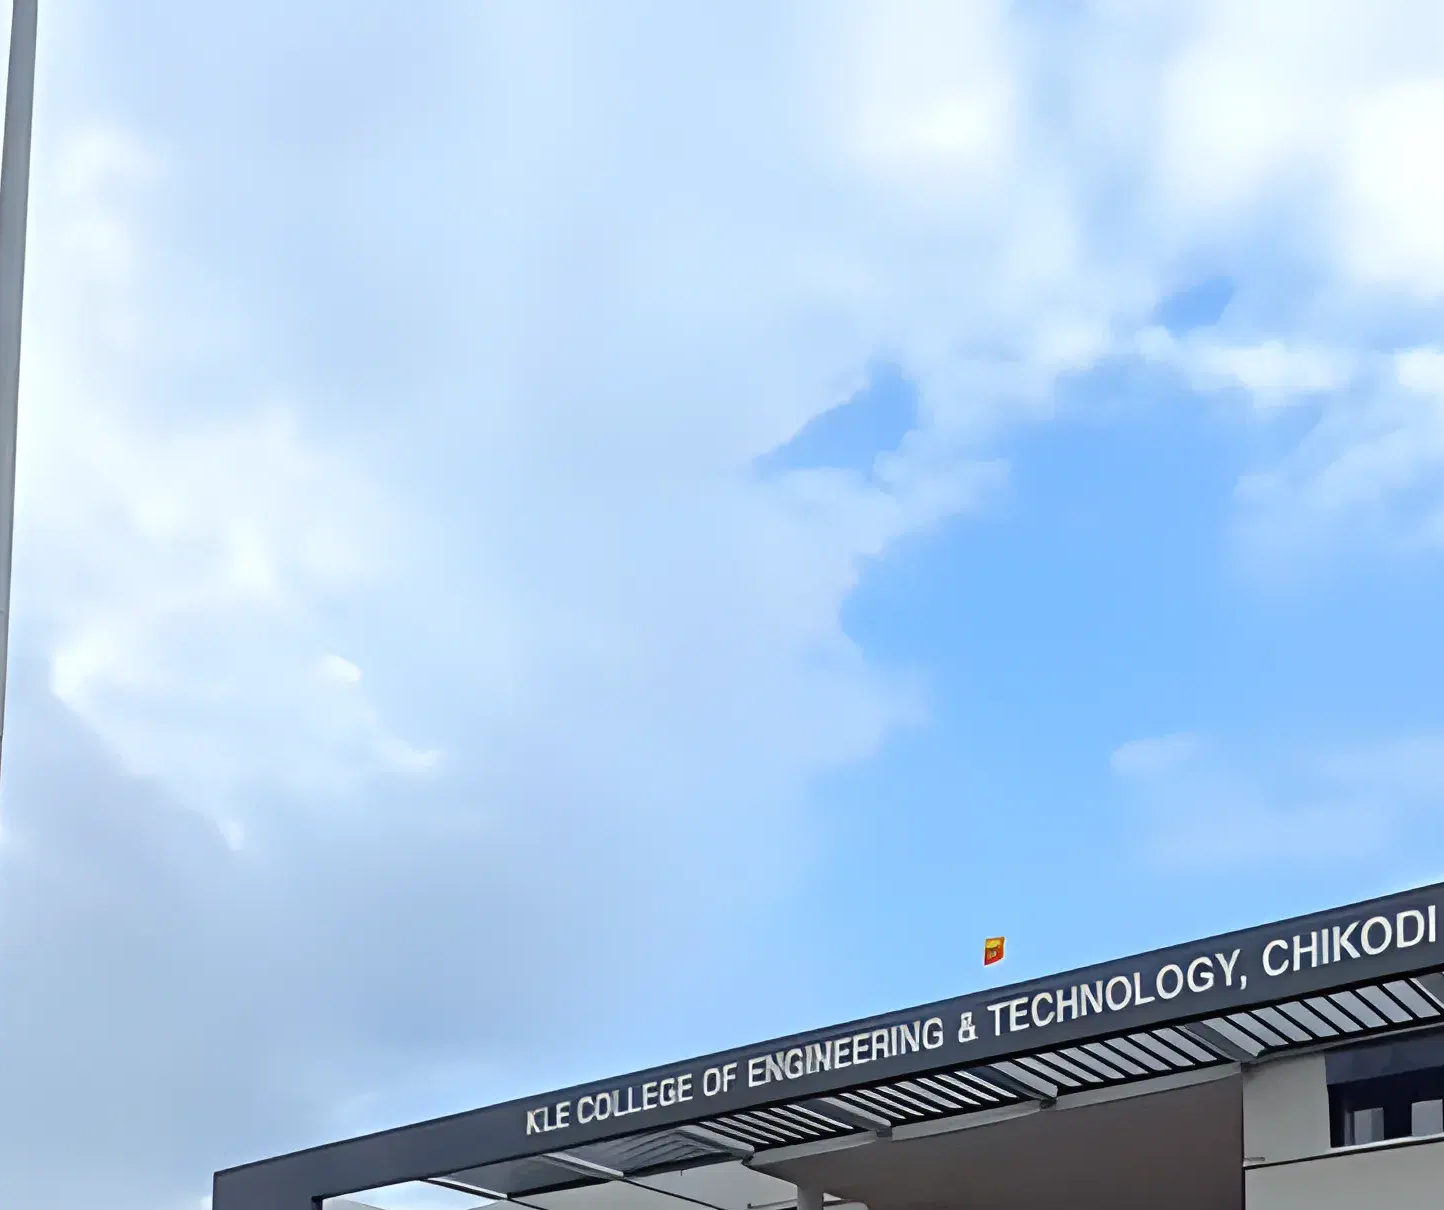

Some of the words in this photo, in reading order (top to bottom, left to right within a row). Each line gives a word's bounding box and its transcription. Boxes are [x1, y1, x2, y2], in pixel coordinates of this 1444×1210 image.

[526, 1101, 570, 1136] KLE
[577, 1073, 694, 1125] COLLEGE
[703, 1062, 738, 1097] OF
[748, 1017, 944, 1088] ENGINEERING
[957, 1011, 979, 1043] &
[986, 948, 1247, 1037] TECHNOLOGY,
[1262, 904, 1436, 977] CHIKODI
